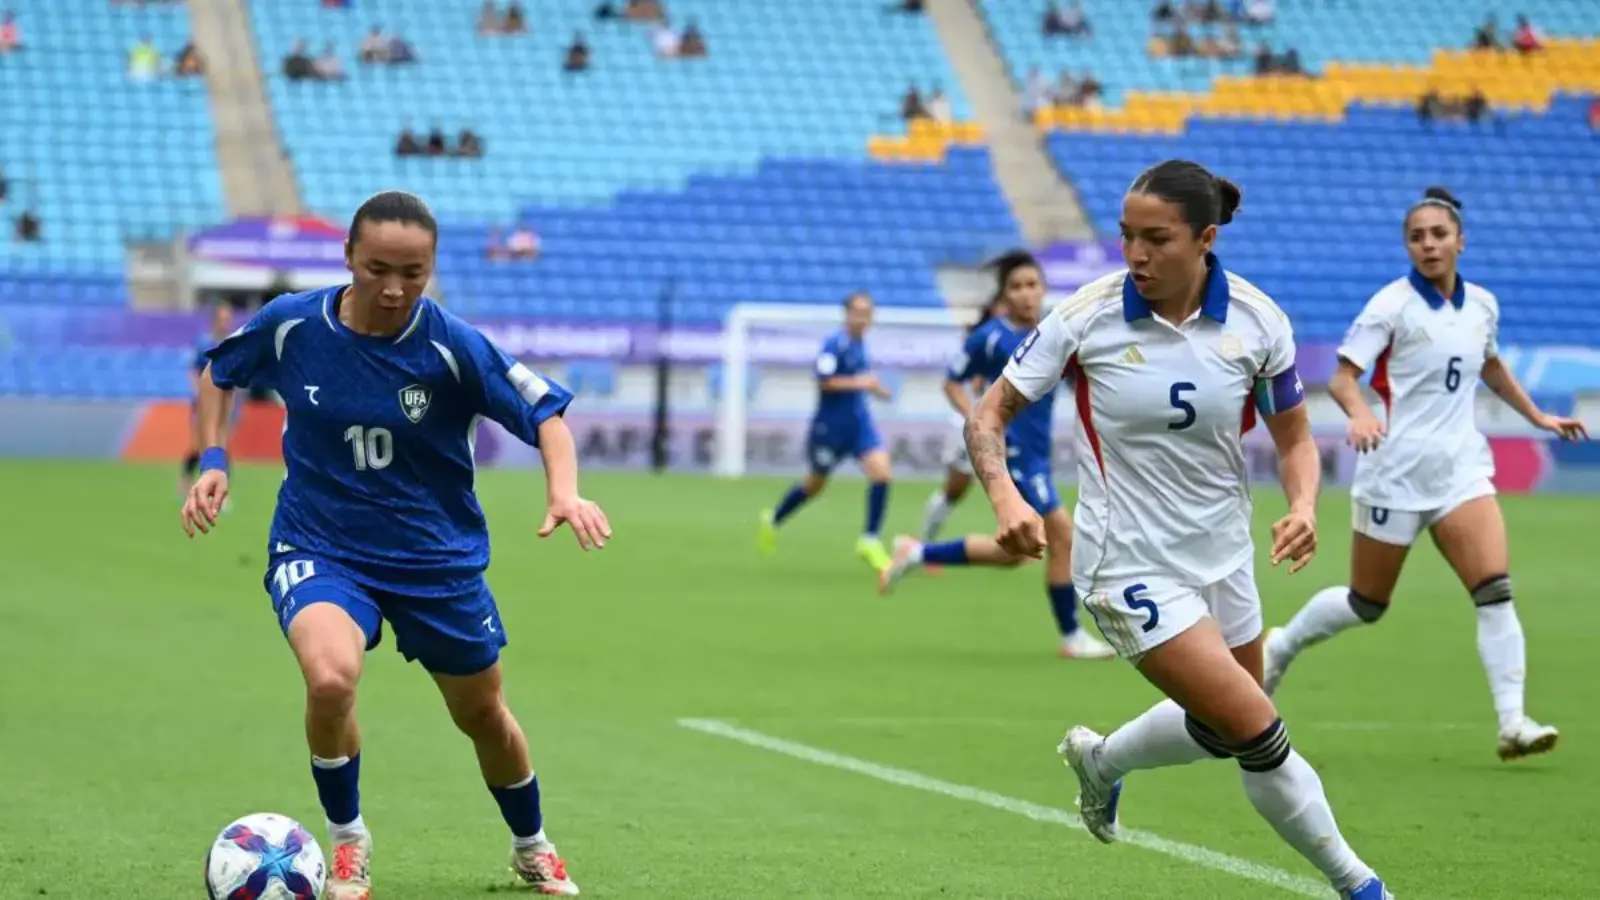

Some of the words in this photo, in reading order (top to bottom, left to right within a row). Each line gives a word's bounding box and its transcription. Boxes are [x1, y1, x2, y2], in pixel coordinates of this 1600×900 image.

[1445, 356, 1462, 393] 6
[404, 390, 426, 405] UFA
[1168, 382, 1196, 430] 5
[344, 425, 393, 471] 10
[273, 560, 315, 598] 10
[1124, 584, 1159, 632] 5
